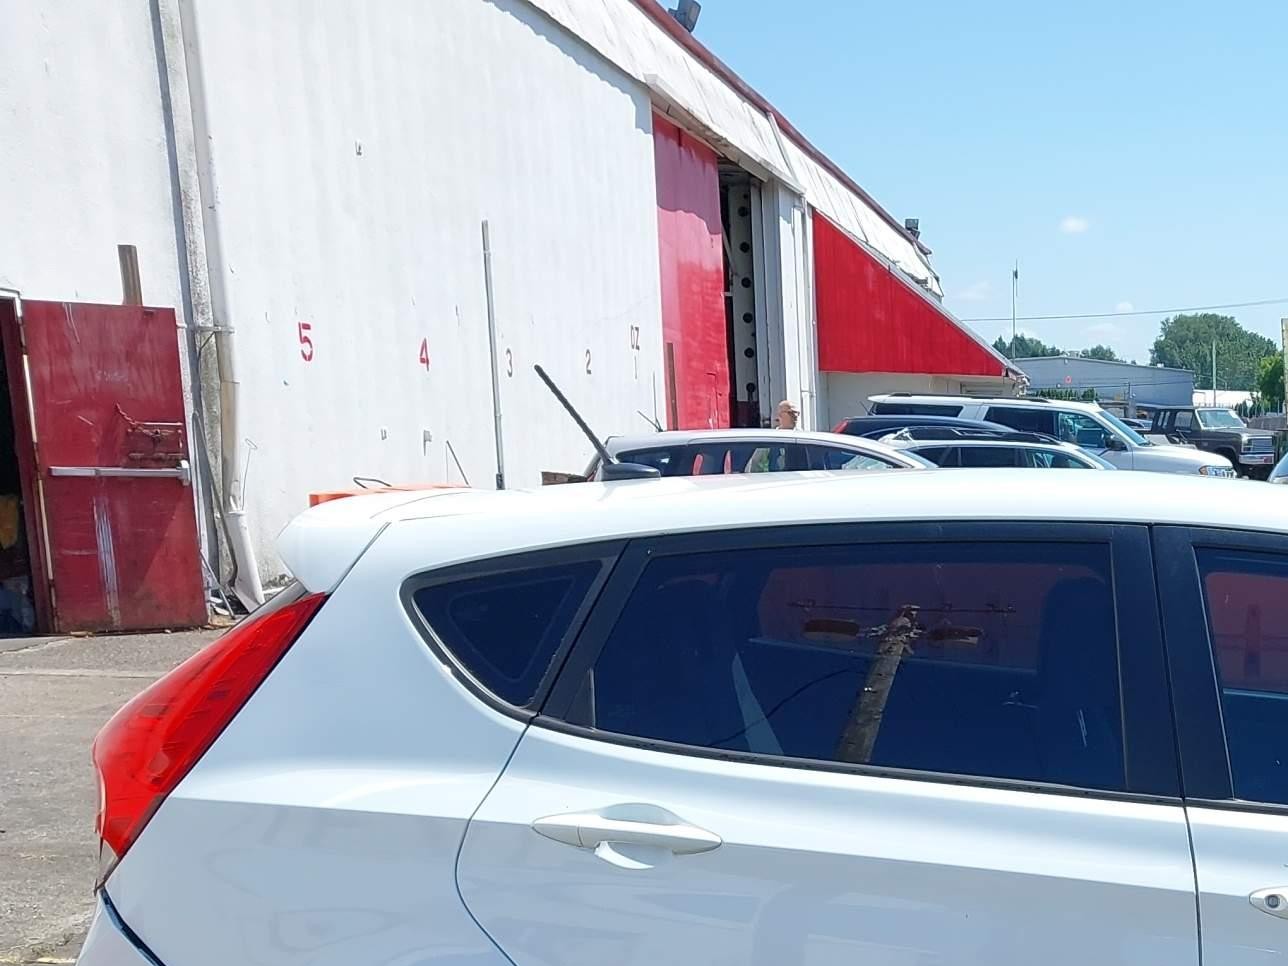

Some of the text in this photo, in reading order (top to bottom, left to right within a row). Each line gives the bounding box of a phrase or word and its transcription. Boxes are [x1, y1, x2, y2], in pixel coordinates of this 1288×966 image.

[298, 322, 313, 362] 5
[420, 338, 429, 372] 4
[506, 348, 513, 378] 3
[585, 349, 592, 375] 2
